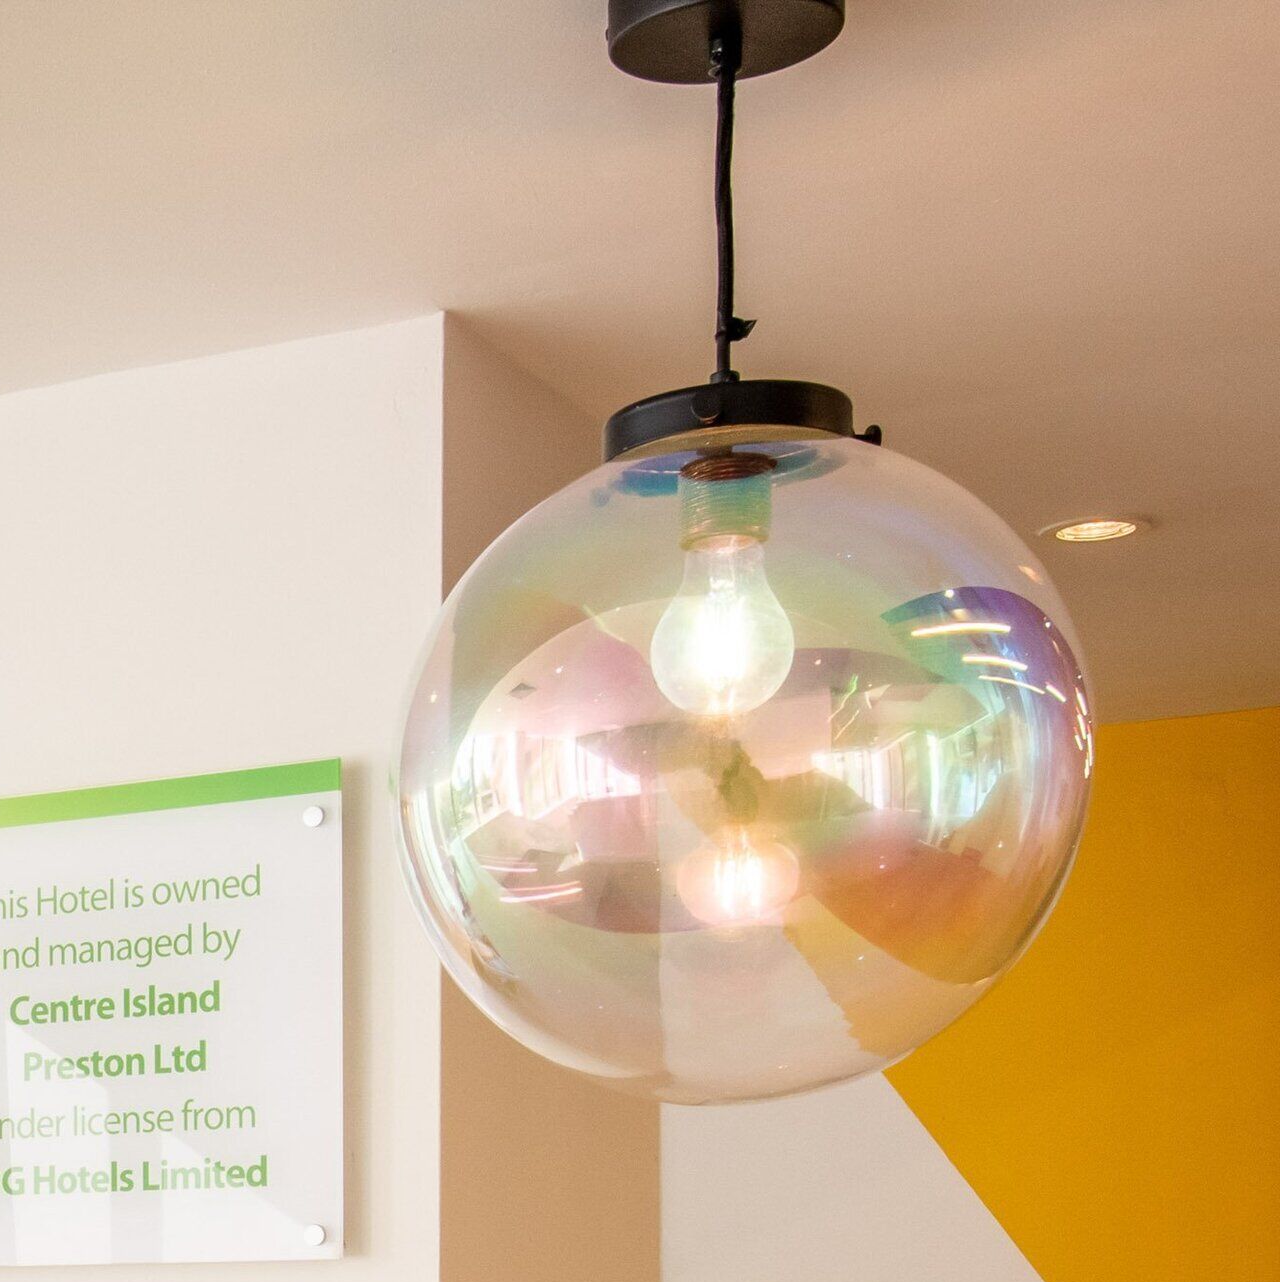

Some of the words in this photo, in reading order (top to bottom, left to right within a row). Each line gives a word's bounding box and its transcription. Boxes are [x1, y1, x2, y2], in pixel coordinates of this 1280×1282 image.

[37, 879, 115, 917] Hotel
[123, 878, 145, 909] is
[152, 863, 262, 906] owned
[49, 923, 194, 969] managed
[202, 922, 243, 962] by
[10, 994, 116, 1026] Centre
[122, 980, 221, 1018] Island
[24, 1050, 146, 1082] Preston
[154, 1039, 208, 1075] Ltd
[71, 1105, 175, 1137] license
[181, 1098, 257, 1132] from
[34, 1161, 136, 1195] Hotels
[141, 1155, 269, 1192] Limited
